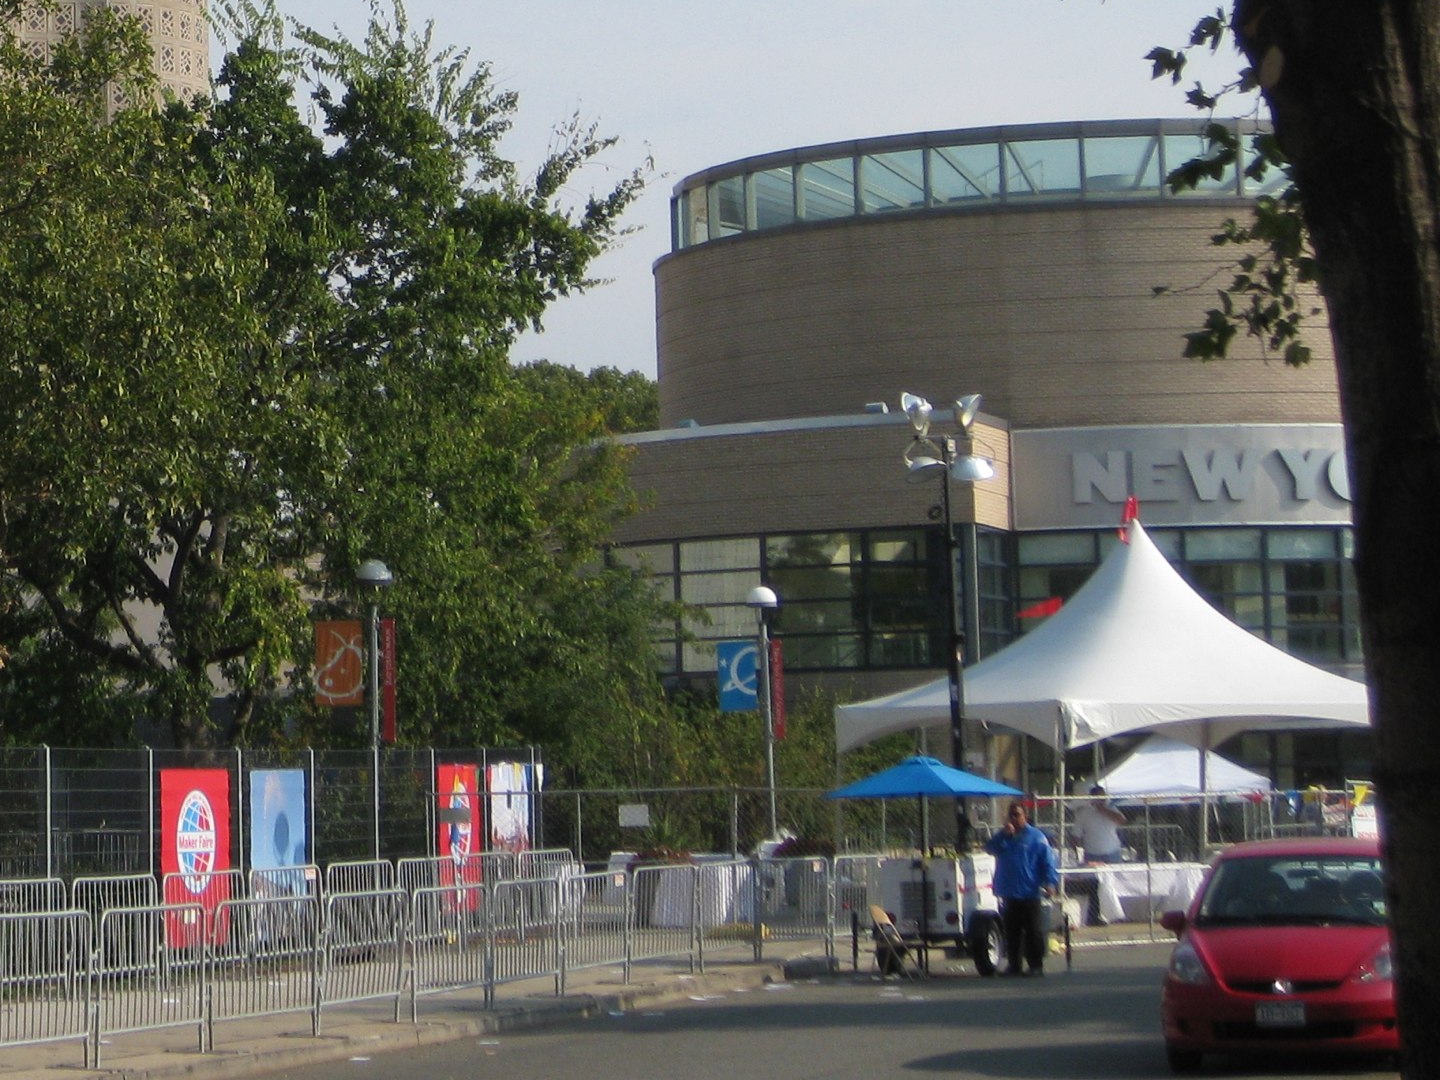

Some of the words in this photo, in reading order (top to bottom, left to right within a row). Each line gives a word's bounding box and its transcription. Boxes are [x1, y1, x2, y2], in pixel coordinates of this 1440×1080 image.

[1072, 448, 1255, 504] NEW
[179, 835, 197, 849] Maker
[200, 835, 213, 849] Faire
